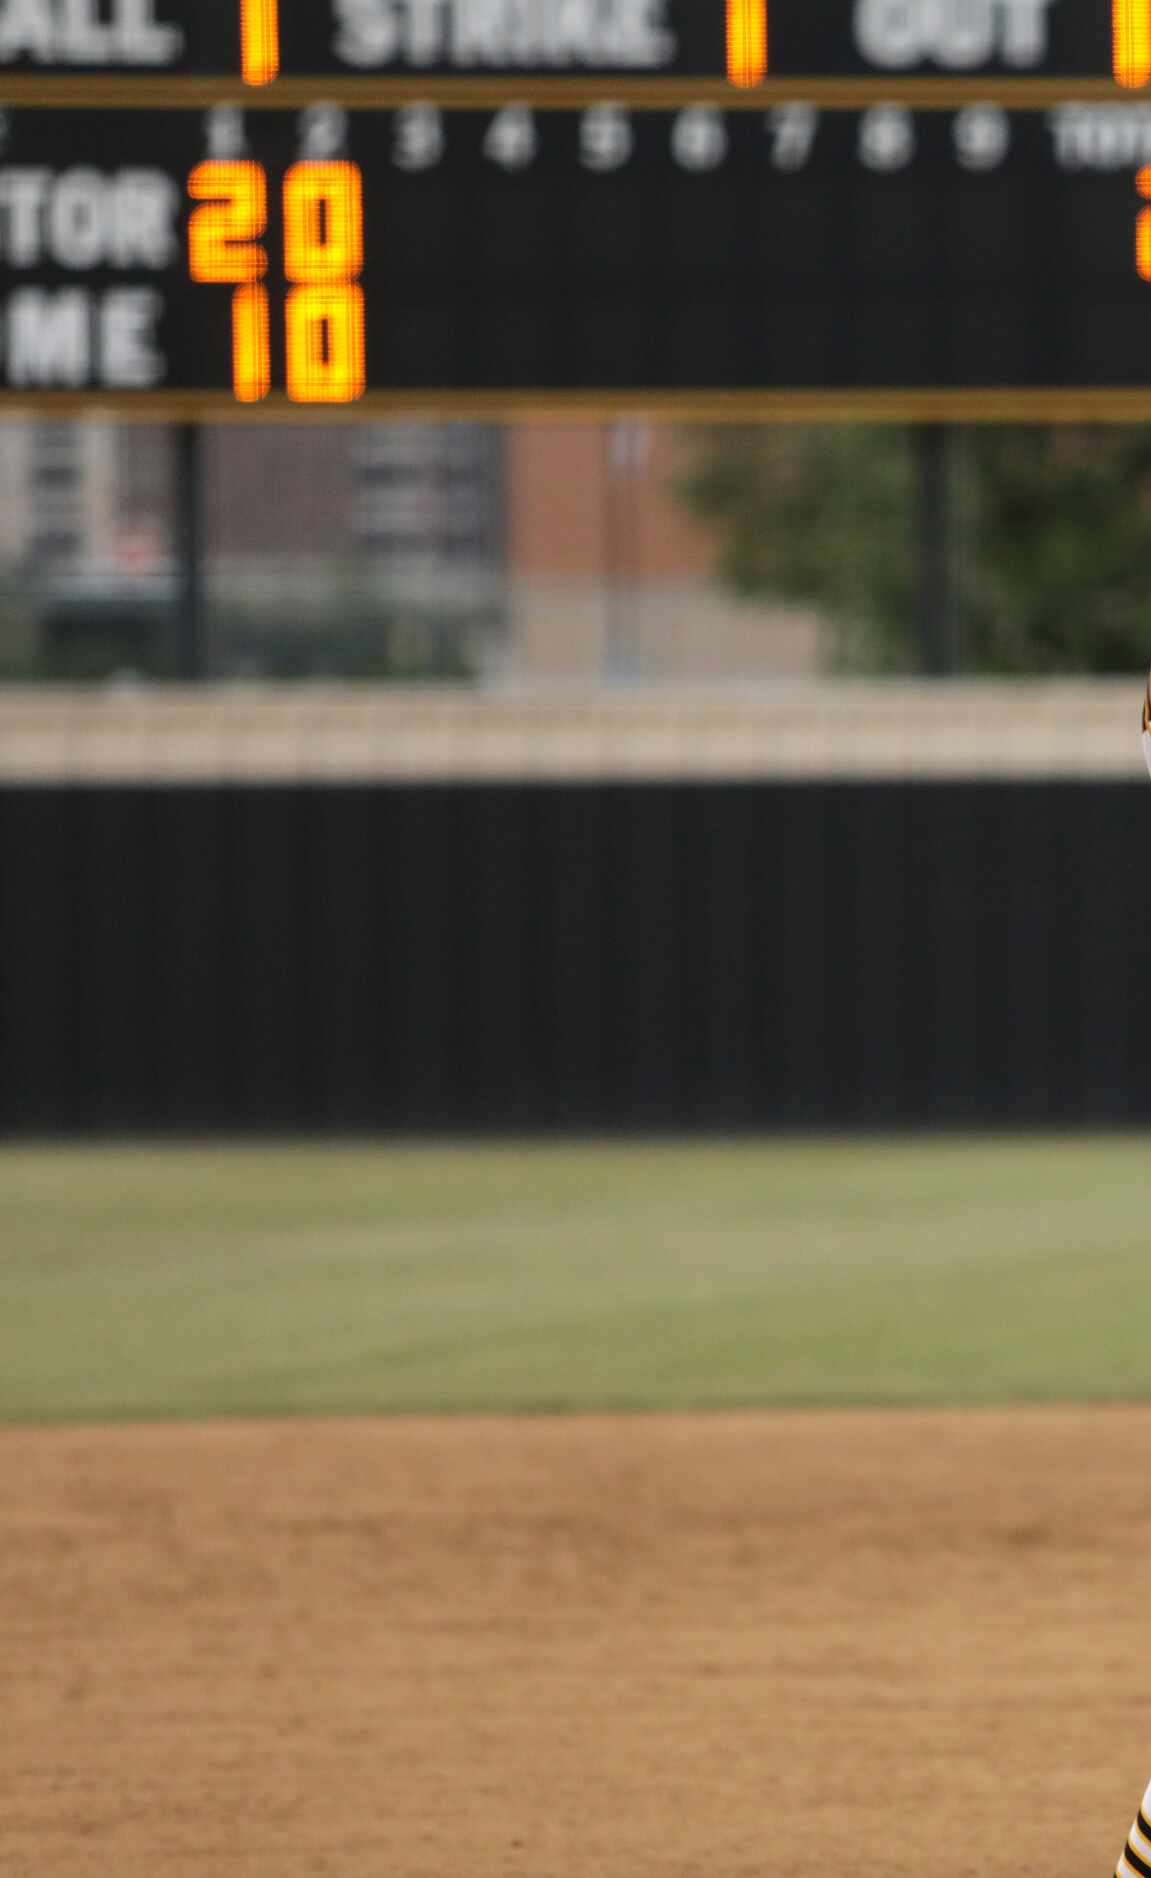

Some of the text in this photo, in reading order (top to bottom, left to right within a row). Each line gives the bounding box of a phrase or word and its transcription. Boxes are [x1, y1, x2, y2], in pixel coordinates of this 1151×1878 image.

[856, 0, 1049, 68] OUT
[207, 102, 246, 160] 1
[299, 102, 347, 160] 2
[394, 102, 443, 170] 3
[485, 102, 535, 170] 4
[580, 102, 631, 170] 5
[671, 103, 727, 171] 6
[768, 102, 817, 171] 7
[859, 103, 912, 171] 8
[954, 103, 1008, 171] 9
